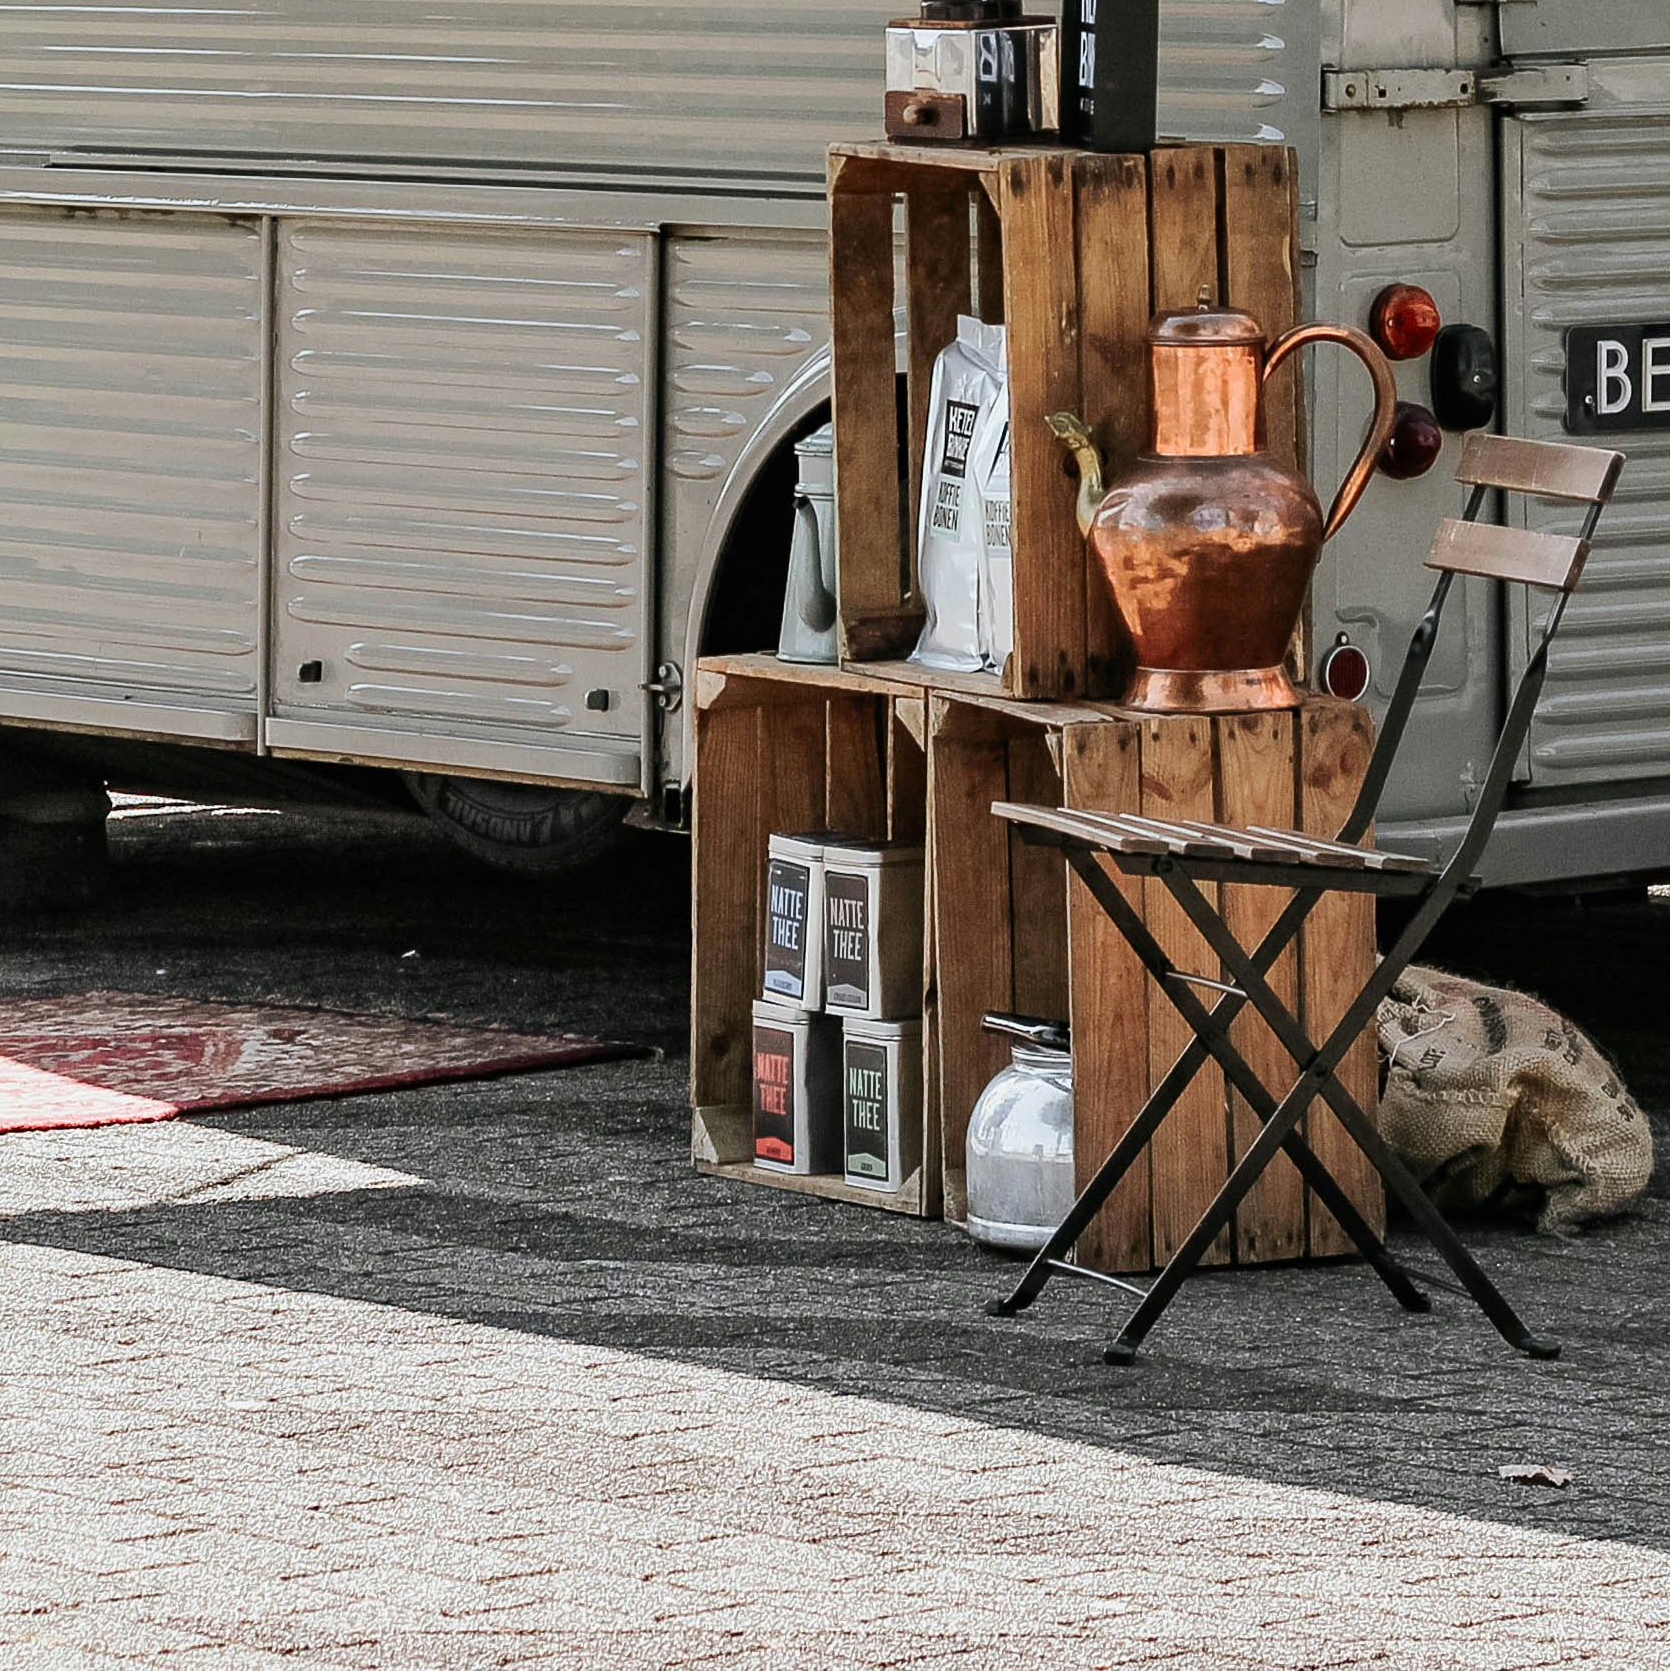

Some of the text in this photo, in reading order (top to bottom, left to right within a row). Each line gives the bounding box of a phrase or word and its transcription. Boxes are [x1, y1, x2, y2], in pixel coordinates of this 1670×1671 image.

[771, 884, 804, 920] NATTE
[830, 897, 864, 930] NATTE
[772, 916, 800, 951] THEE
[833, 930, 863, 961] THEE
[756, 1052, 789, 1085] NATTE
[849, 1067, 883, 1101] NATTE
[759, 1083, 787, 1116] THEE
[852, 1099, 881, 1131] THEE
